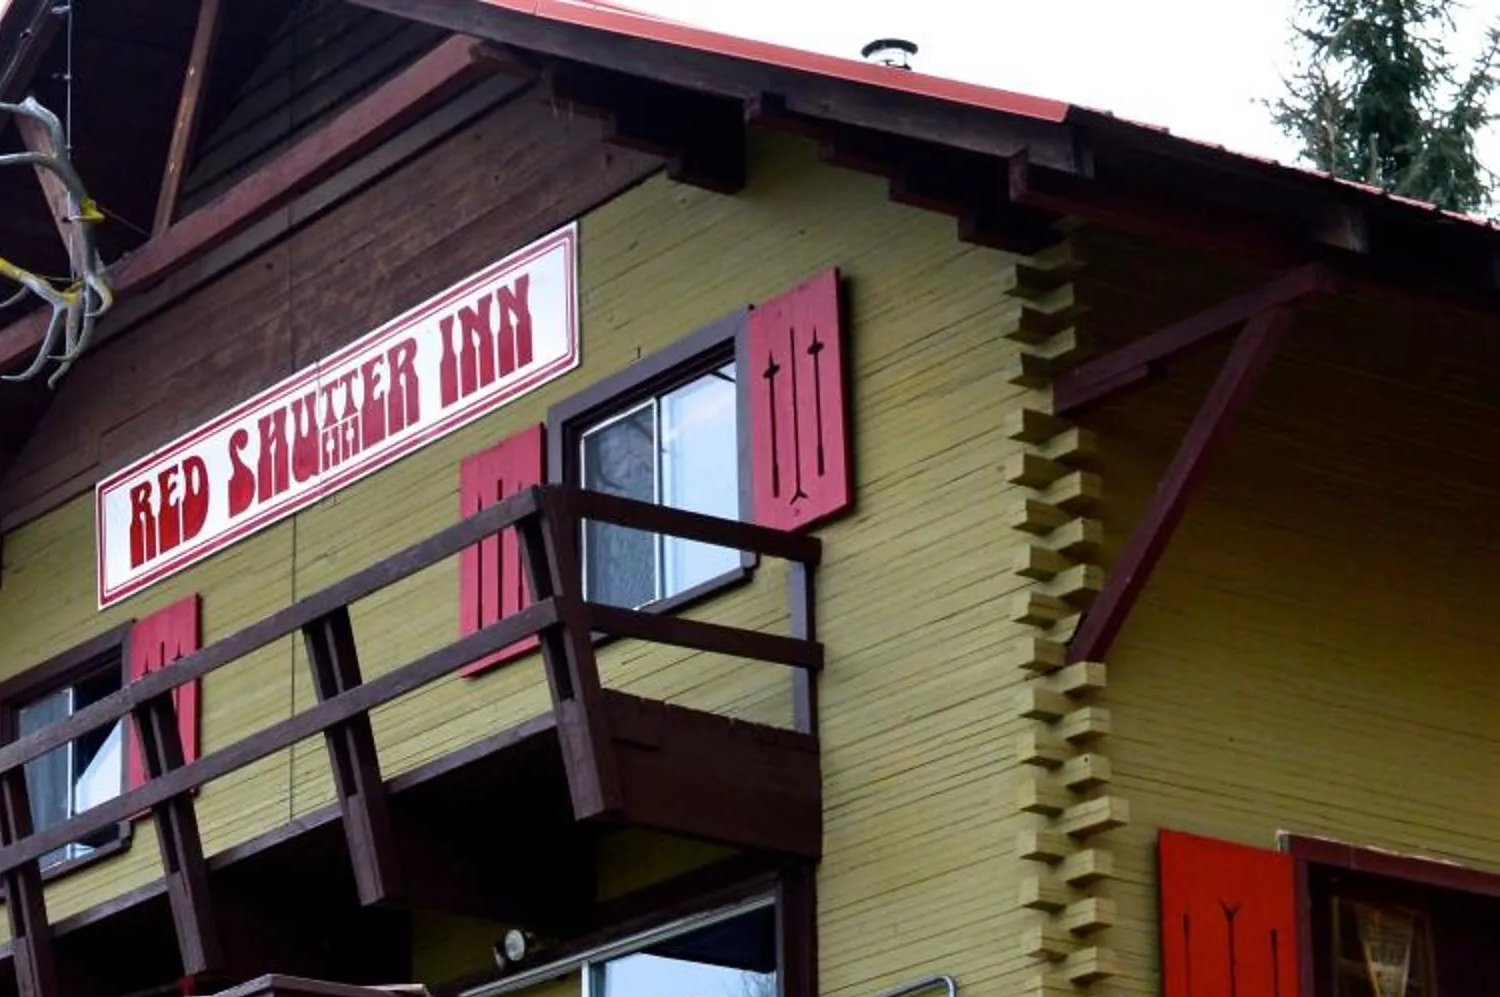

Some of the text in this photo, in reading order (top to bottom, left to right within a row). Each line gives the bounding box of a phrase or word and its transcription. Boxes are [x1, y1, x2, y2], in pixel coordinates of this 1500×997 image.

[129, 274, 533, 570] RED SHUTTER INN
